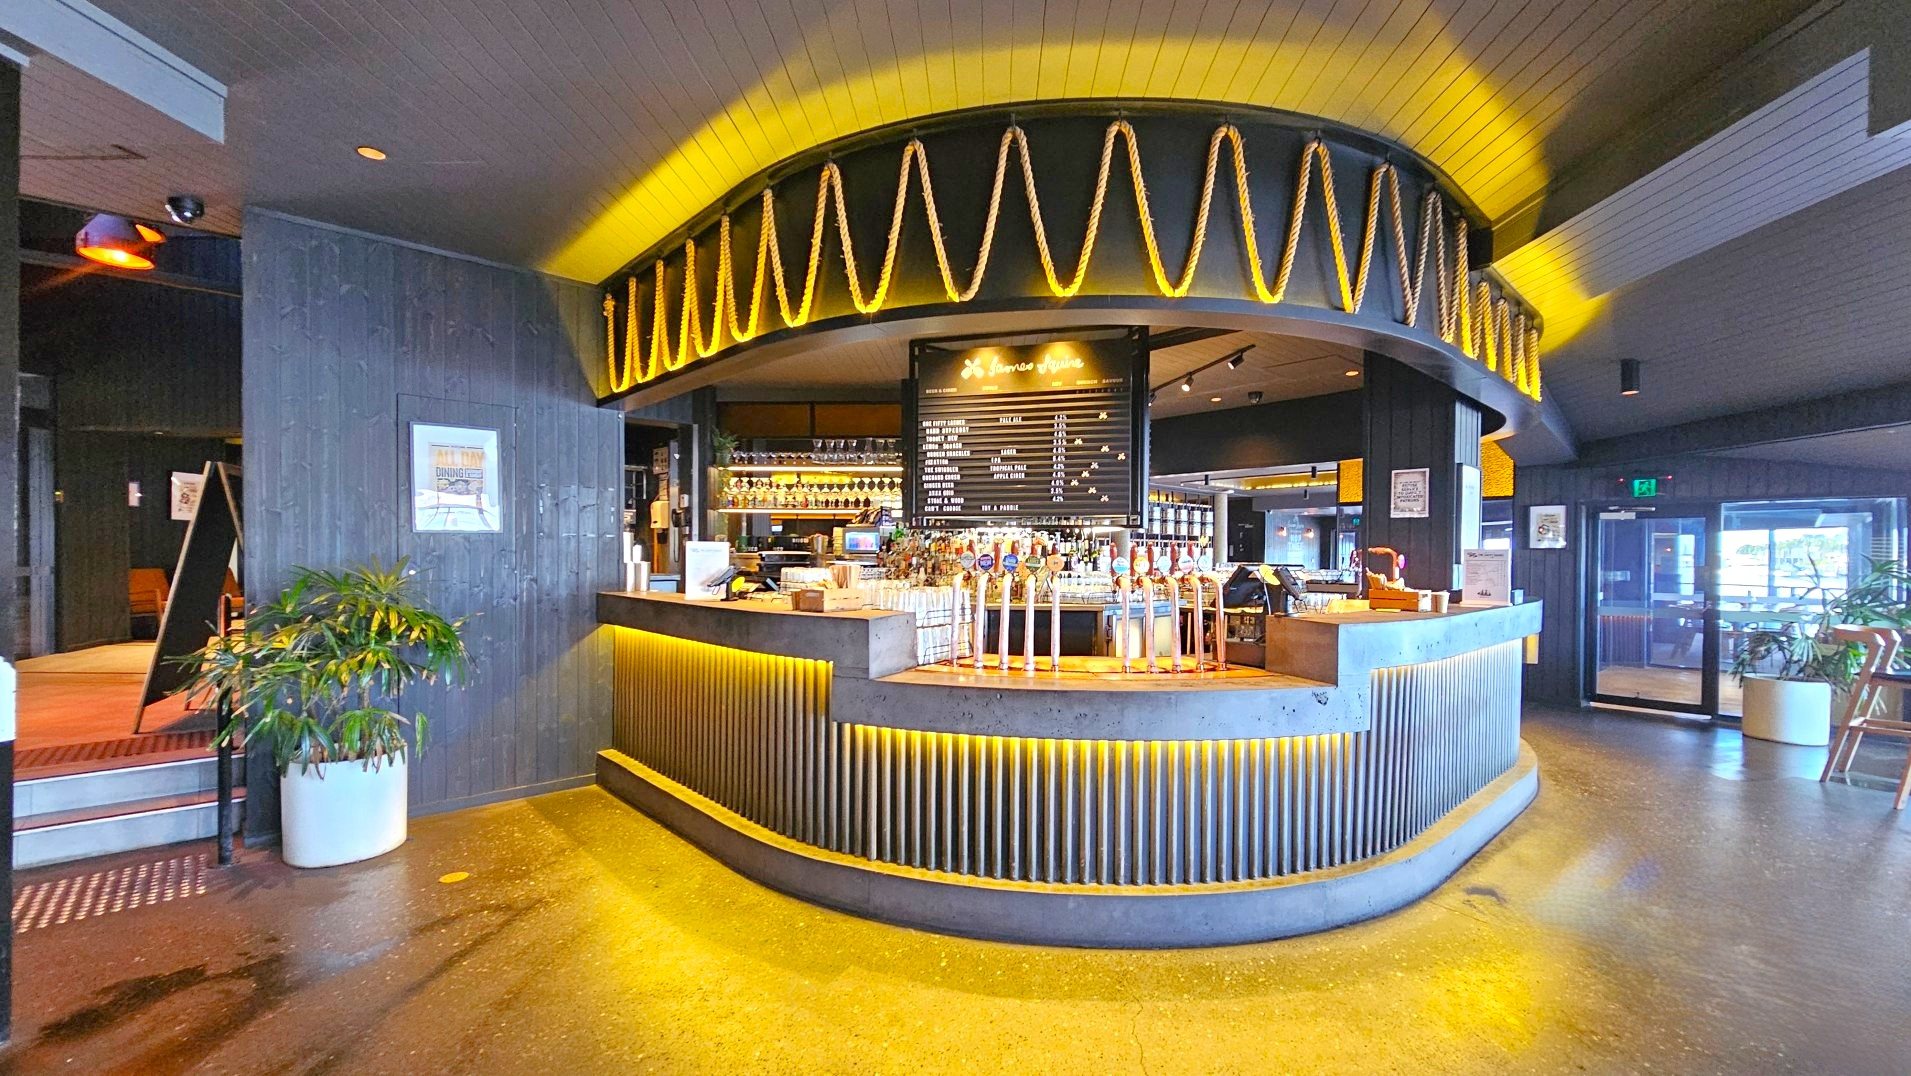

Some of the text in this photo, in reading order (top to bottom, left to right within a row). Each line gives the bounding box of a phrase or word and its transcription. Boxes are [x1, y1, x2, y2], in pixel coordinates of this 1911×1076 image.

[989, 354, 1084, 377] James Squire
[436, 450, 485, 468] ALL DAY
[436, 466, 464, 478] DINING
